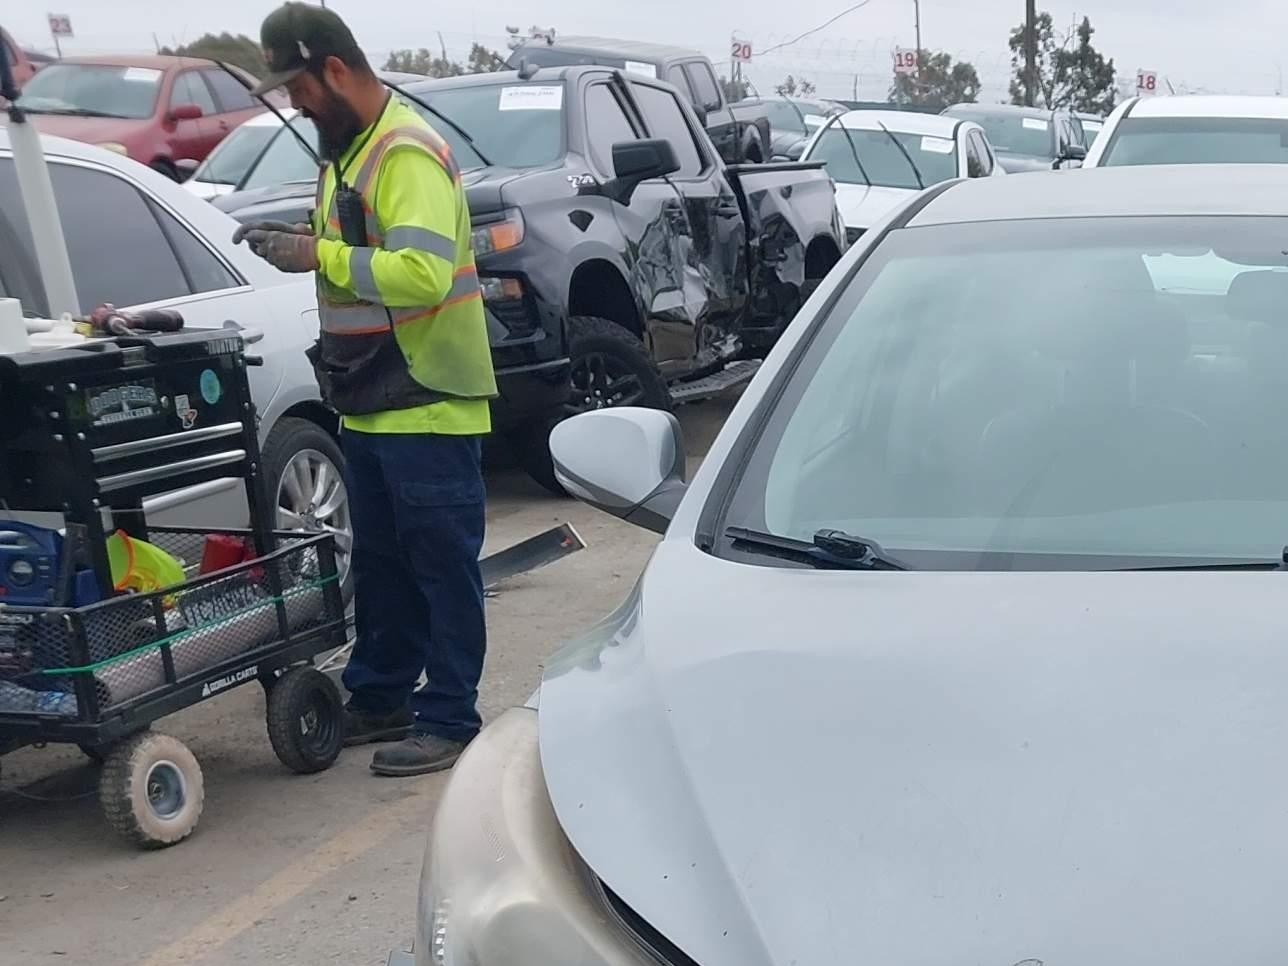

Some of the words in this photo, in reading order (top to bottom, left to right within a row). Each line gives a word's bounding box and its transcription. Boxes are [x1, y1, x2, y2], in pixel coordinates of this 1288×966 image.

[732, 43, 752, 60] 20
[896, 52, 915, 68] 19
[1136, 74, 1156, 90] 18
